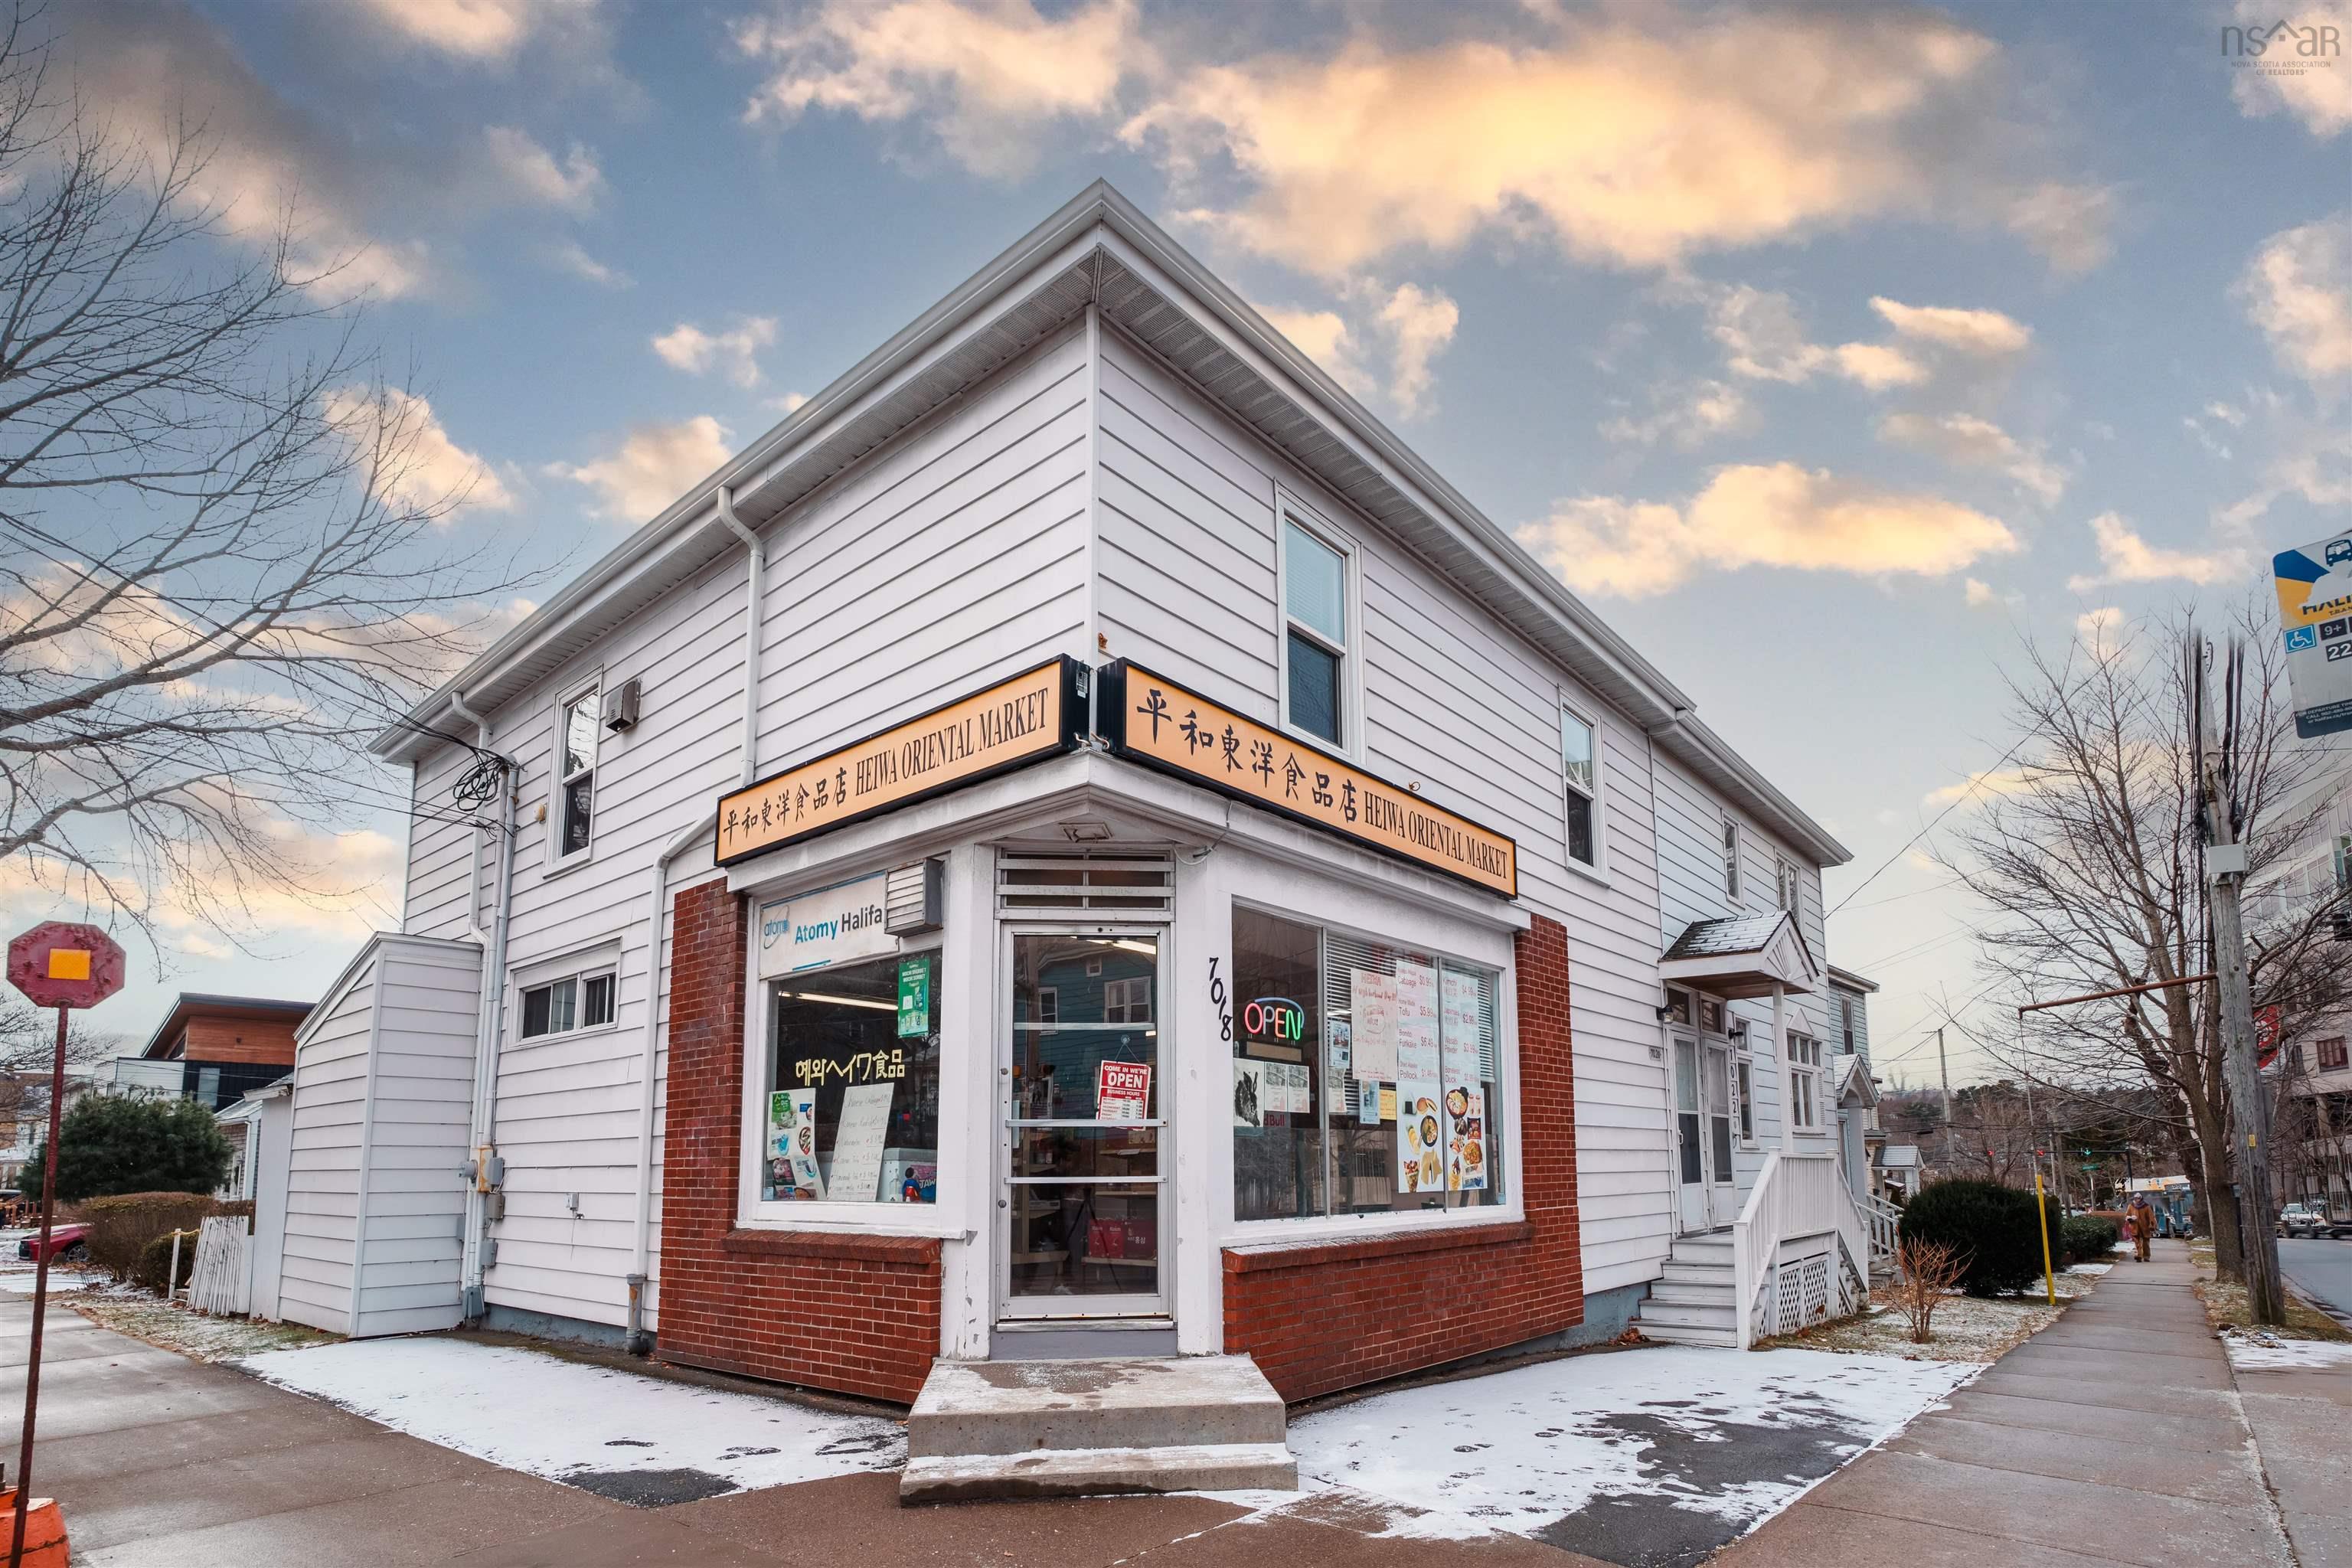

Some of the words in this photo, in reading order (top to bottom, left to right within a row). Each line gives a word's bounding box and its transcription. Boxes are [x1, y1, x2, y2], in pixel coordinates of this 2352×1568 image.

[2327, 643, 2352, 660] 22
[723, 768, 847, 847] 平和東洋食品店
[855, 748, 897, 797] HEIWA
[902, 718, 975, 779] ORIENTAL
[978, 688, 1048, 753] MARKET
[1136, 688, 1357, 824] 平和東洋食品店
[1364, 789, 1406, 838] HEIWA
[1409, 809, 1465, 861] ORIENTAL
[1466, 836, 1508, 880] MARKET
[795, 920, 838, 945] Atomy
[841, 903, 883, 933] Halifa
[1209, 956, 1233, 1042] 7018
[1399, 1006, 1410, 1017] Tofu
[1419, 1005, 1433, 1018] $5.99
[1462, 1013, 1475, 1024] $2.99
[1244, 1002, 1302, 1040] OPEN
[1421, 1036, 1434, 1048] $6.49
[1107, 1072, 1143, 1089] OPEN
[1400, 1070, 1418, 1080] Pollock
[1445, 1074, 1458, 1084] Duck
[1270, 1114, 1285, 1125] Bull
